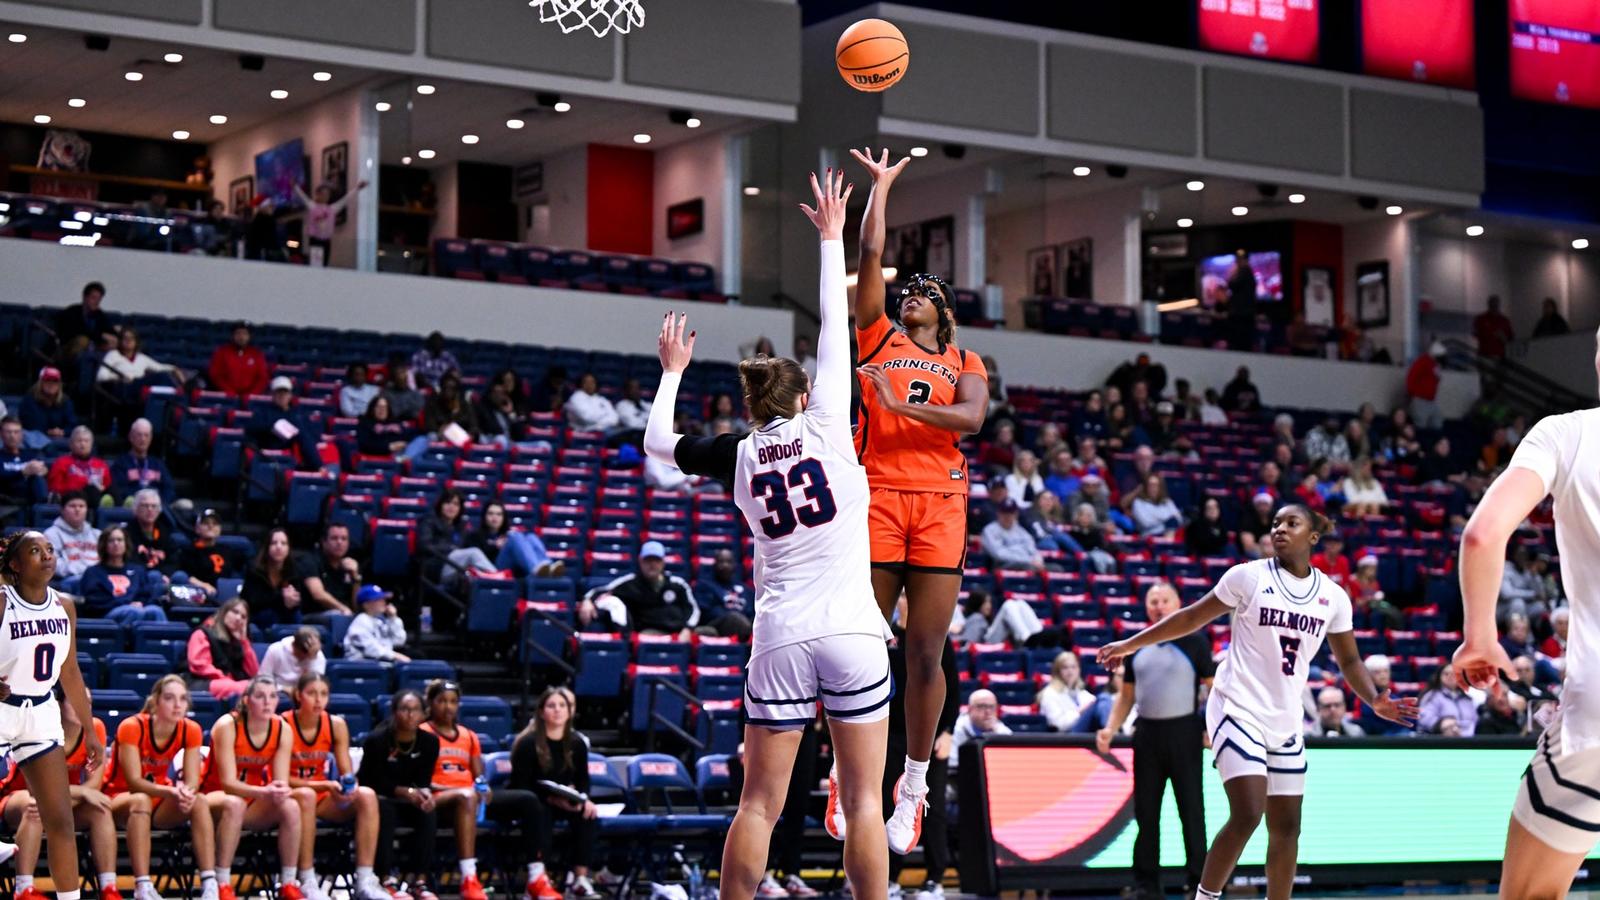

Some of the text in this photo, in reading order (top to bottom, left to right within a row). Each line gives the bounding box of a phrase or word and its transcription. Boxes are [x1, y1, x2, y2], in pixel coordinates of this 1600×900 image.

[853, 67, 899, 84] Wilson
[907, 379, 932, 405] 2
[750, 456, 836, 539] 33
[209, 553, 225, 573] P
[9, 617, 69, 641] BELMONT
[1259, 606, 1325, 638] BELMONT
[33, 642, 56, 682] 0
[1279, 634, 1301, 676] 5
